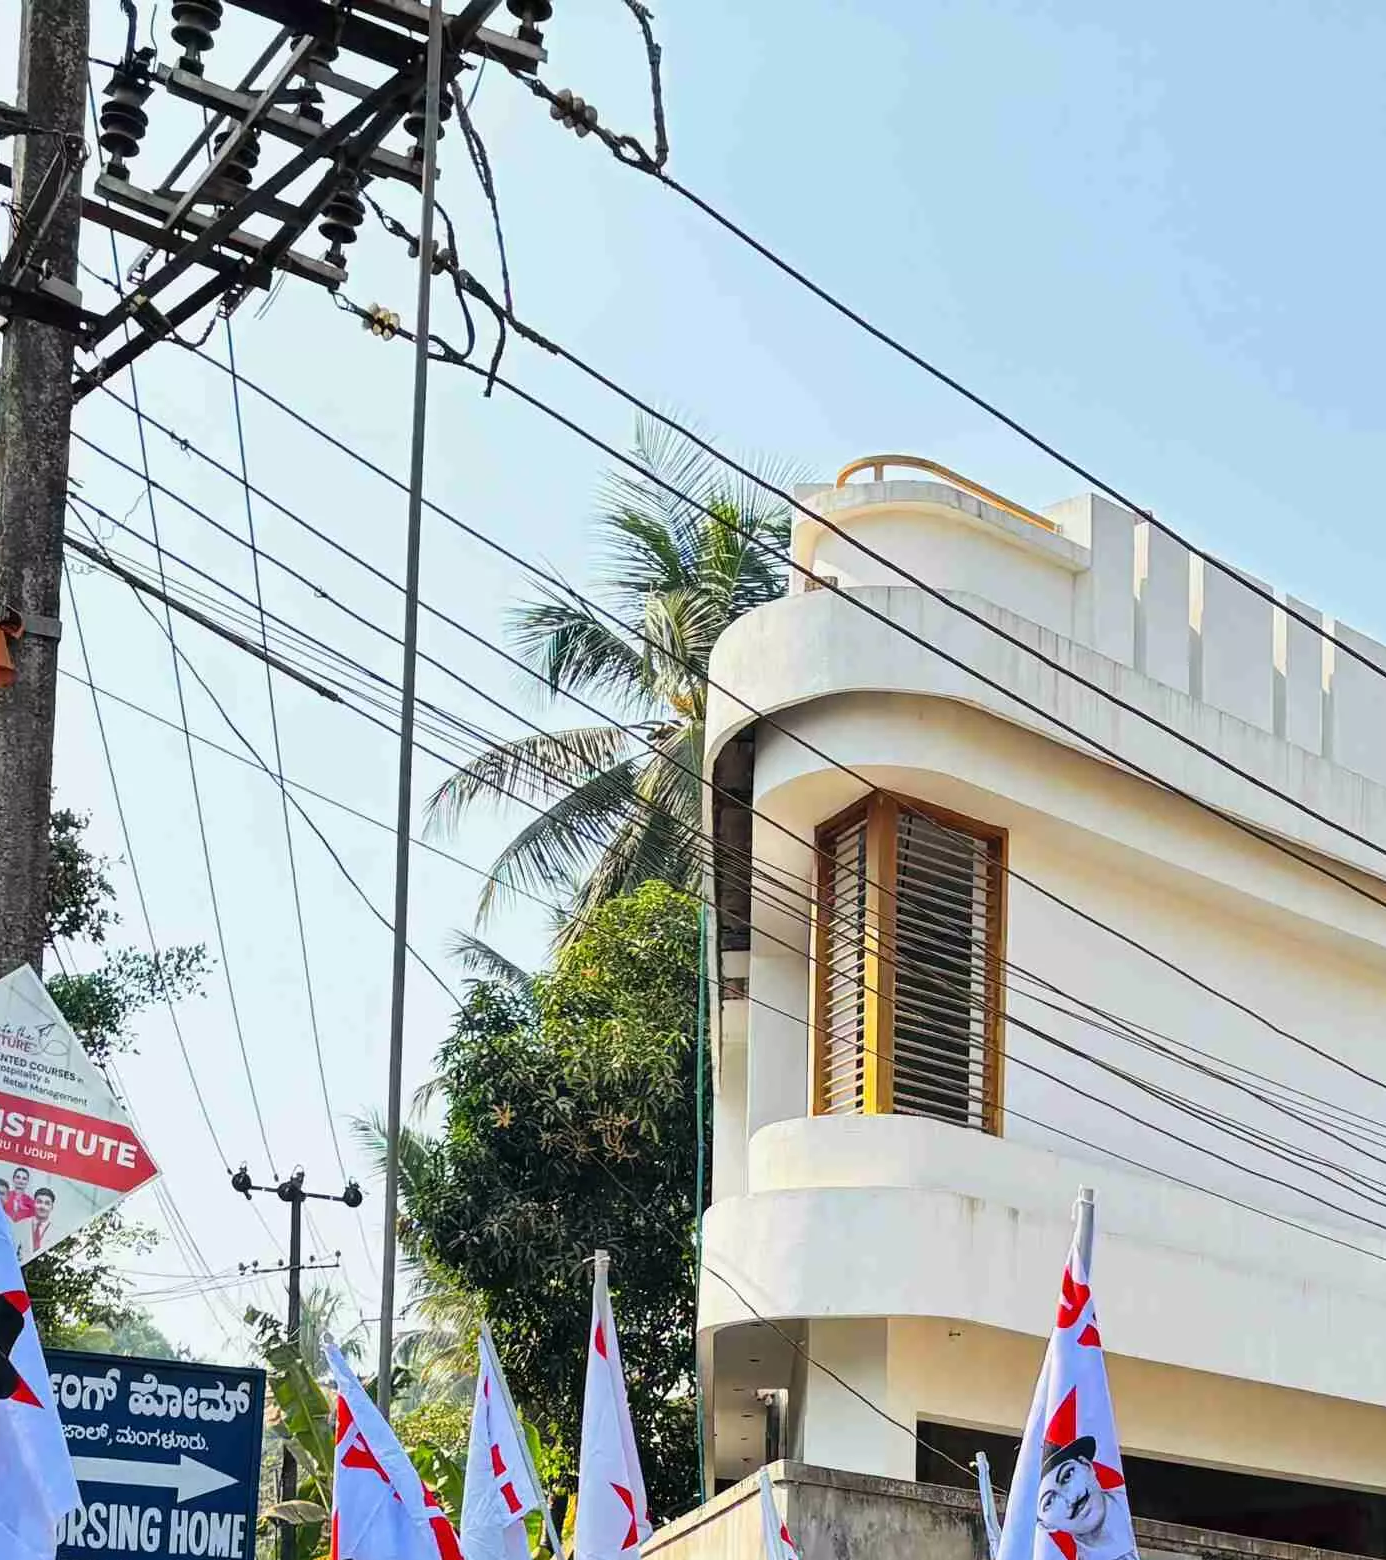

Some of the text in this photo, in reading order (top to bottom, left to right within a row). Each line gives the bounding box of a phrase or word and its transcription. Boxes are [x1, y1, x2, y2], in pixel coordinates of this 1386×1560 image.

[29, 1061, 76, 1082] COURSES
[30, 1084, 88, 1107] Management
[23, 1146, 58, 1163] UDUPI
[168, 1509, 246, 1559] HOME
